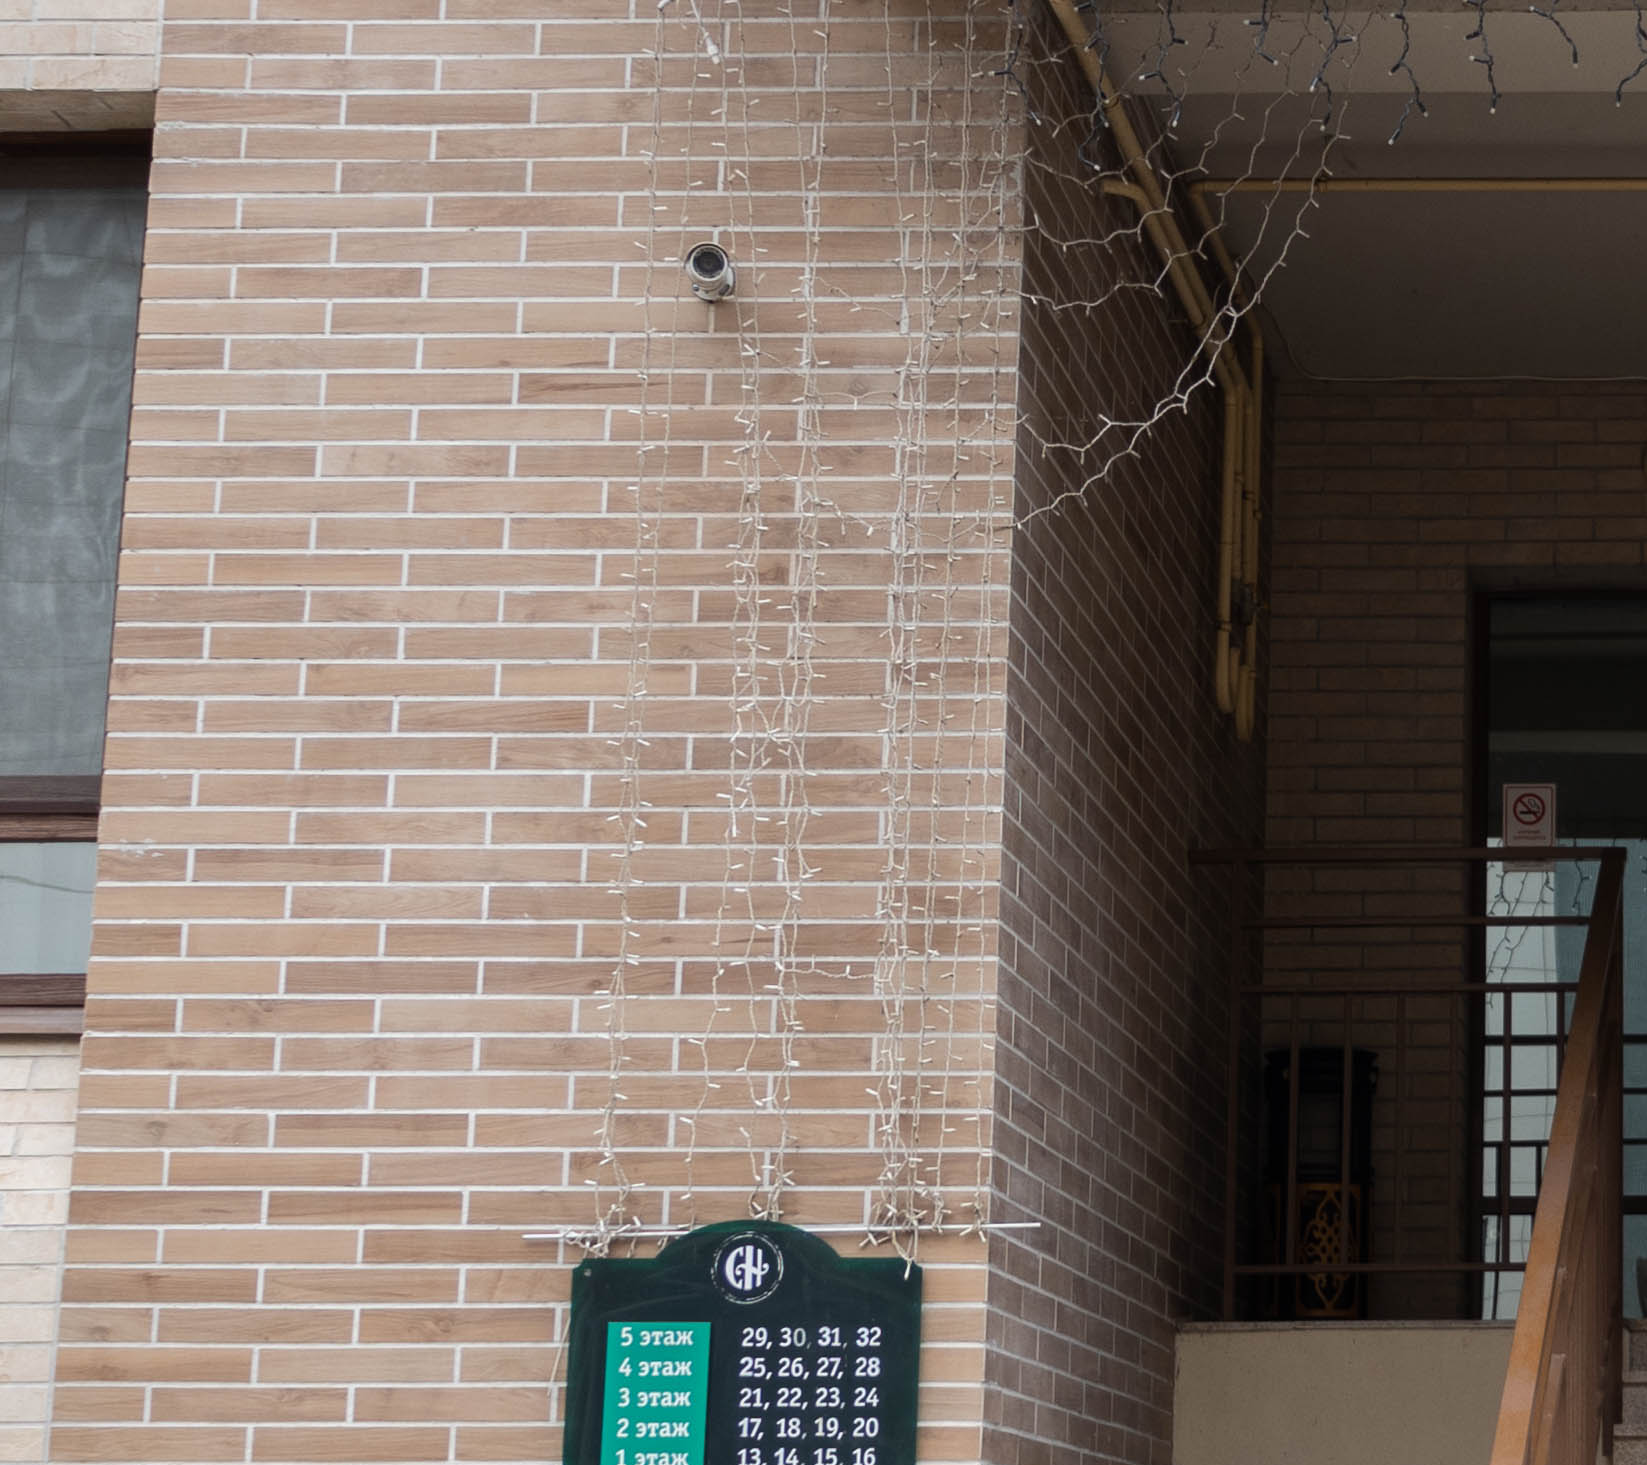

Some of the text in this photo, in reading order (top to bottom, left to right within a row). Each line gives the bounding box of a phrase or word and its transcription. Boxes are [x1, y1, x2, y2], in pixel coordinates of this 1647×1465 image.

[621, 1327, 632, 1346] 5
[640, 1331, 693, 1346] этаж
[742, 1328, 772, 1349] 29,
[818, 1327, 848, 1349] 31,
[856, 1327, 881, 1346] 32
[619, 1357, 880, 1379] 4 этаж 25, 26, 27, 28
[618, 1387, 879, 1410] 3 этаж 21, 22, 23, 24
[617, 1418, 878, 1440] 2 этаж 17, 18, 19, 20
